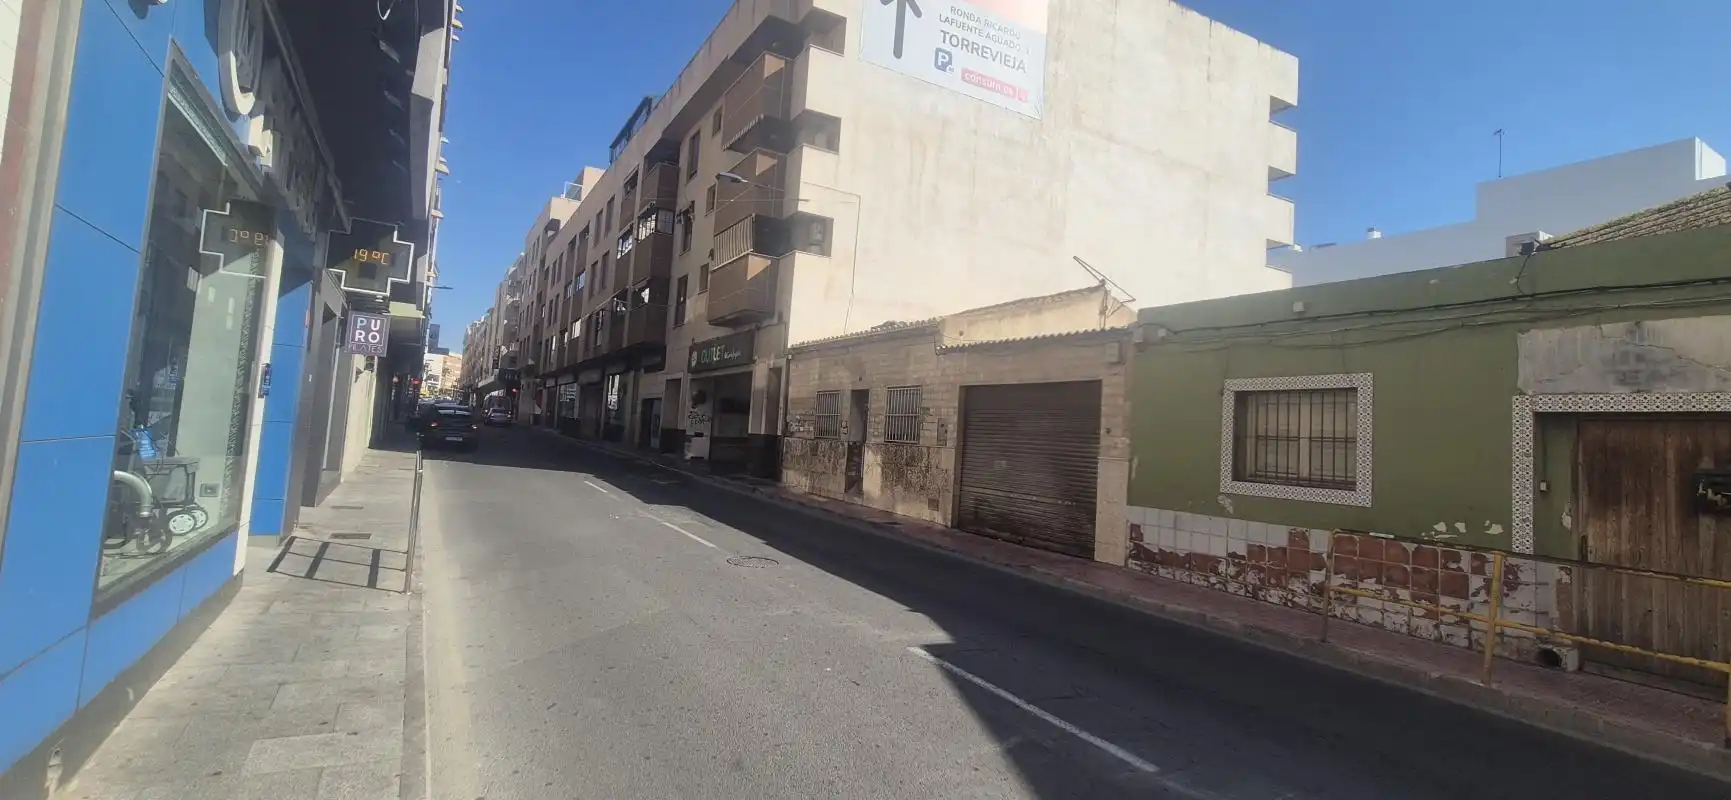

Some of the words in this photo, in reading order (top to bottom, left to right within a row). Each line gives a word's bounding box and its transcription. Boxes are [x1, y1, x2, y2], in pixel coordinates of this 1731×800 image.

[939, 13, 983, 38] LAFUENTE
[950, 6, 982, 25] RONDA
[984, 18, 1021, 40] RICARDO
[940, 29, 1027, 74] TORREVIEJA
